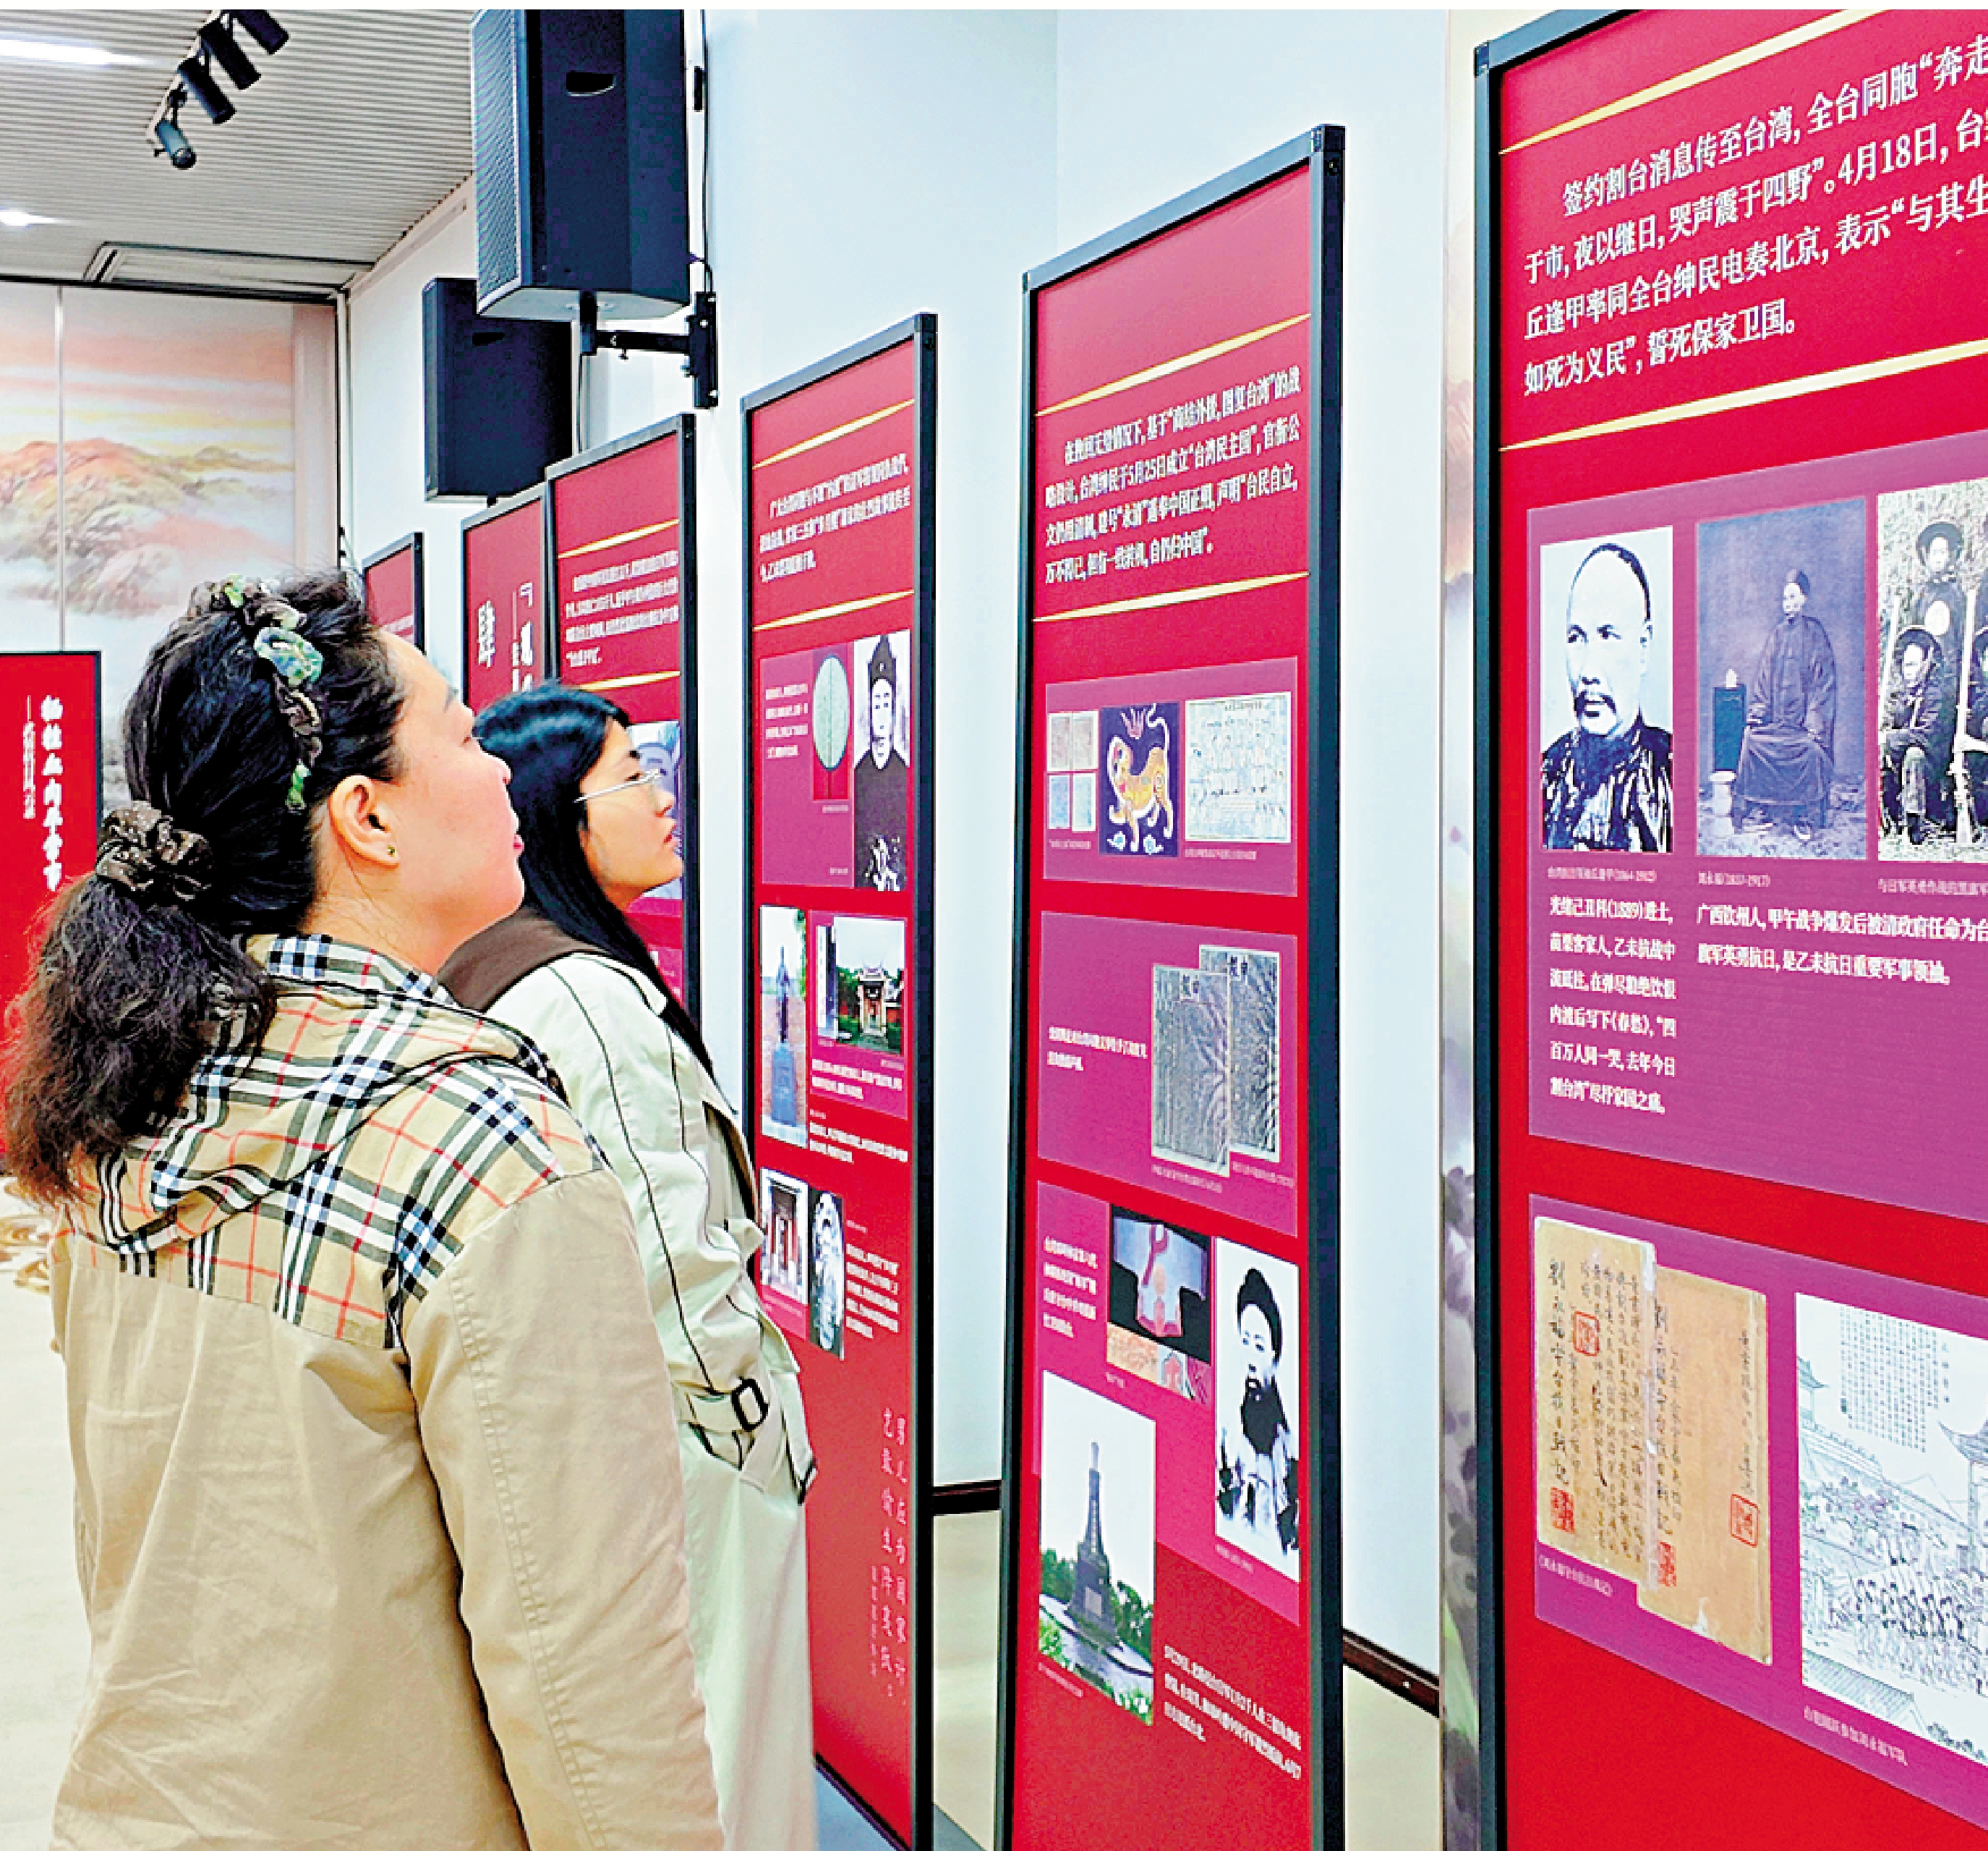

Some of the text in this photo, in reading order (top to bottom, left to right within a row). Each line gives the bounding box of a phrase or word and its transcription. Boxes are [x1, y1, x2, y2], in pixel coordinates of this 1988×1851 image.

[1524, 108, 1988, 284] 于市，夜以继日，哭声震于四野”。4月18日，台
